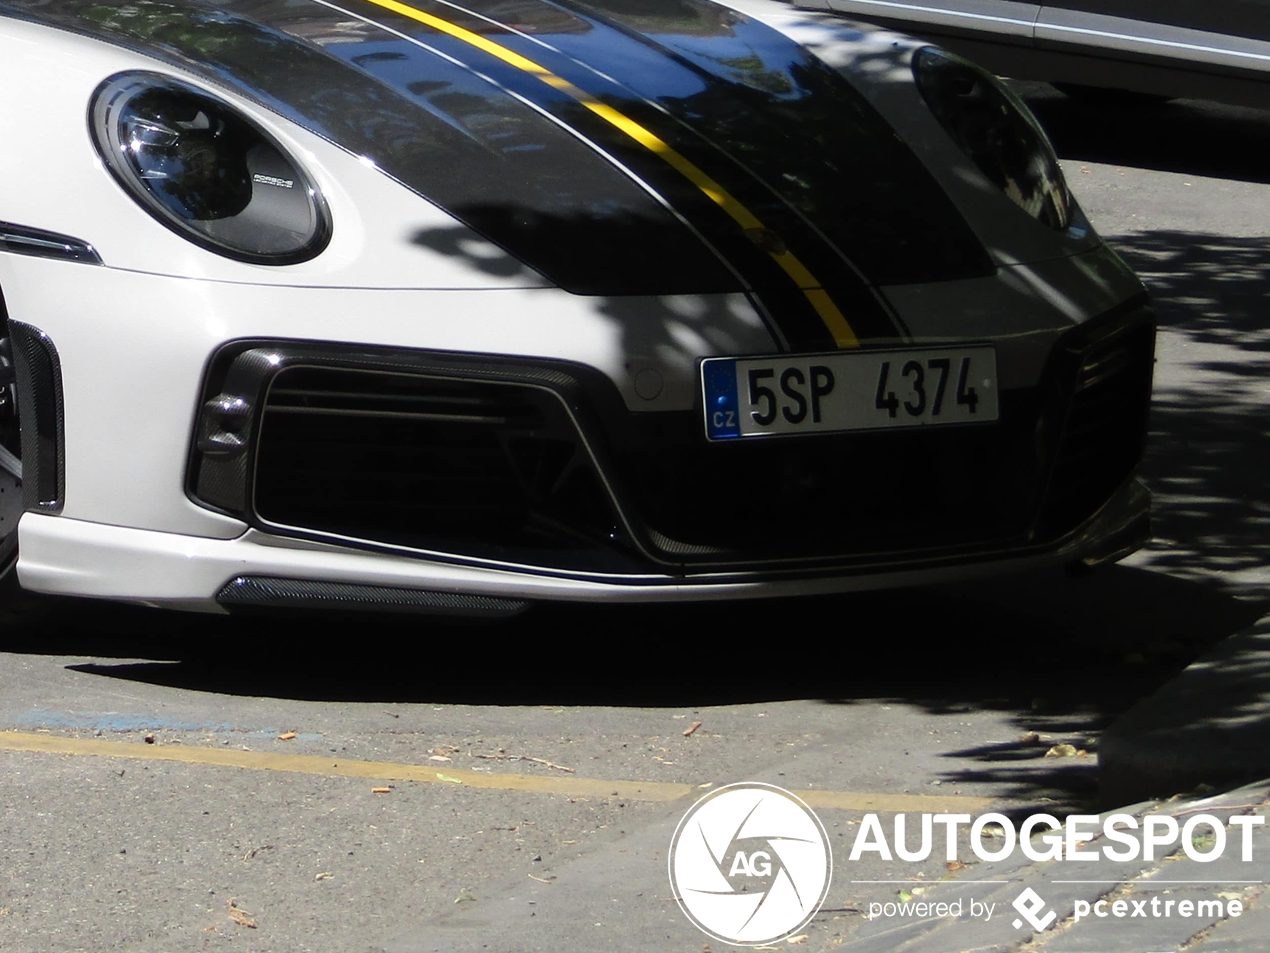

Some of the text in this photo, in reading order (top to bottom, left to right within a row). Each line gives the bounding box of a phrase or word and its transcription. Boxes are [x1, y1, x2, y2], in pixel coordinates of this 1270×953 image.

[748, 357, 978, 427] 5SP 4374
[713, 411, 736, 429] CZ
